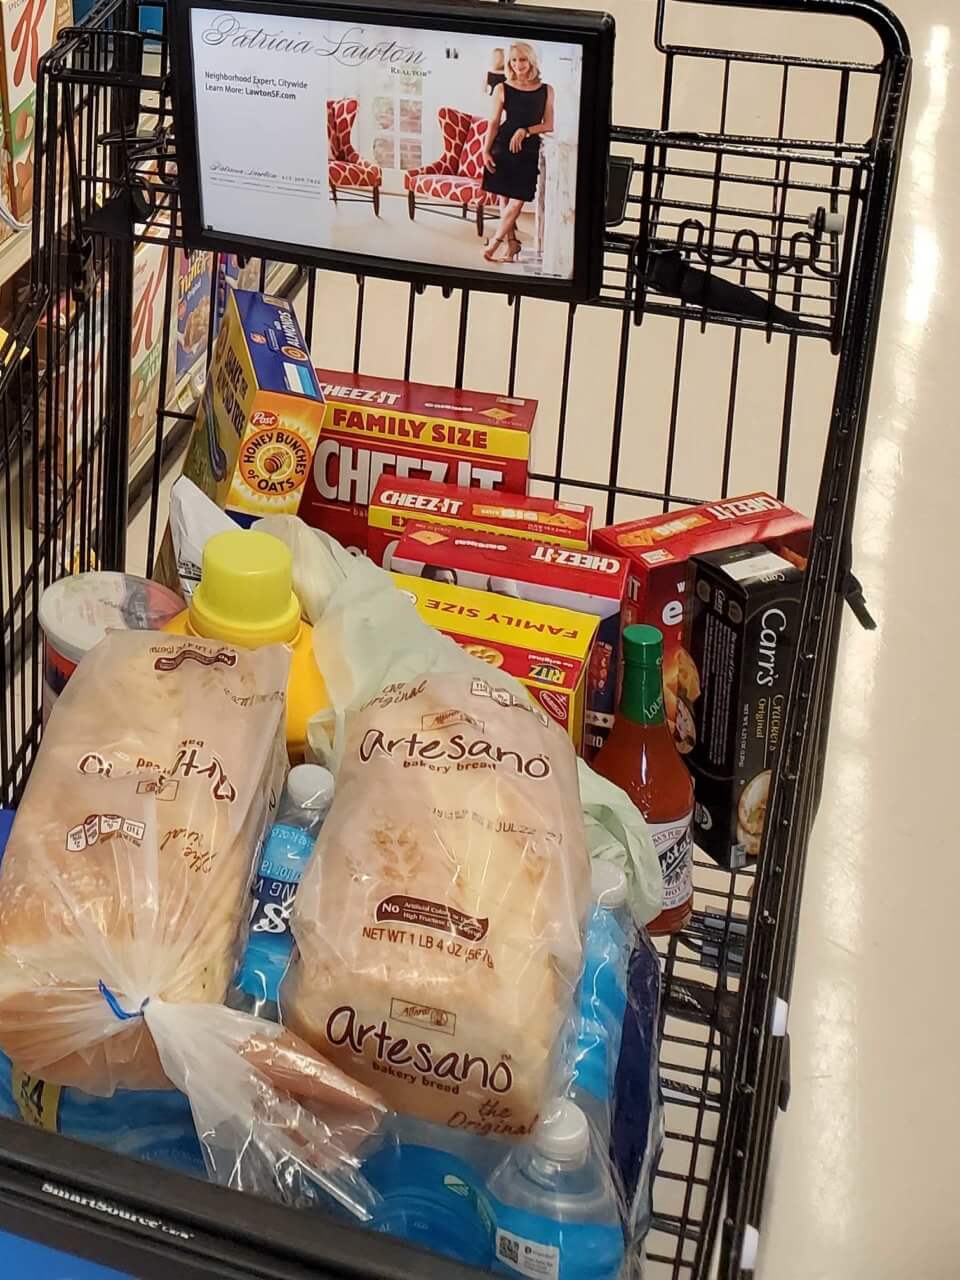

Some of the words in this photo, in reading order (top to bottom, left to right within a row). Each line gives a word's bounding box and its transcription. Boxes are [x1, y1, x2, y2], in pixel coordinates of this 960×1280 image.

[201, 13, 314, 55] Patricia
[314, 27, 428, 67] Lawton
[204, 71, 253, 86] Neighborhood
[252, 75, 278, 89] Expert,
[277, 78, 309, 91] Citywide
[204, 83, 224, 95] Learn
[224, 84, 245, 96] More:
[244, 86, 297, 101] LawtonSF.com
[279, 310, 300, 348] ALMONDS
[252, 411, 276, 426] Post
[332, 408, 424, 440] FAMILY
[432, 423, 488, 449] SIZE
[243, 432, 274, 464] HONEY
[276, 431, 307, 476] BUNCHES
[425, 599, 480, 619] SIZE
[486, 612, 580, 640] FAMILY
[755, 608, 787, 688] Carr's
[528, 663, 567, 685] RITZ
[381, 902, 400, 914] No
[372, 1061, 418, 1087] bakery
[421, 1073, 460, 1096] bread
[478, 1097, 512, 1120] the
[41, 1182, 159, 1230] SmartSource
